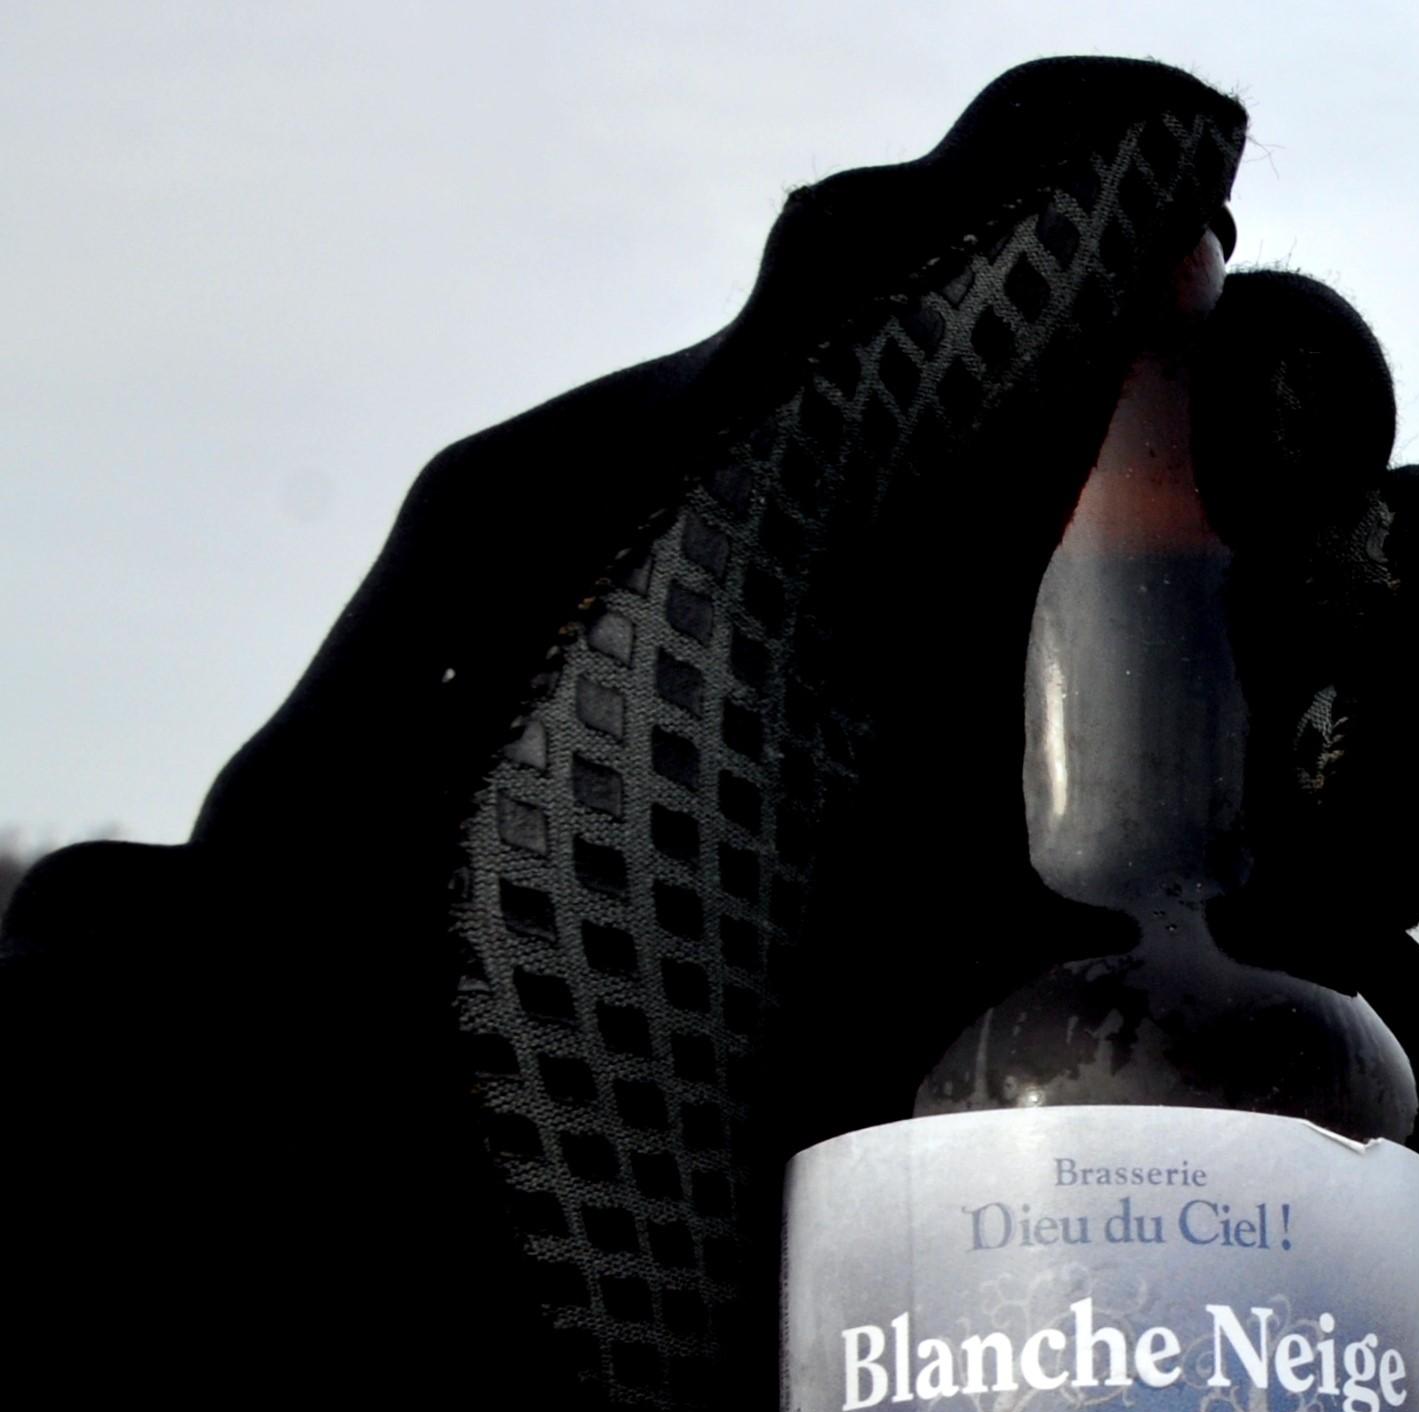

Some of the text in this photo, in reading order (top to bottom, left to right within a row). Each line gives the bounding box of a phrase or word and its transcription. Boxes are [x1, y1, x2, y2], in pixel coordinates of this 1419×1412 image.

[1055, 1157, 1207, 1187] Brasserie
[962, 1201, 1092, 1251] Dieu
[1104, 1197, 1166, 1244] du
[841, 1298, 1181, 1412] Blanche
